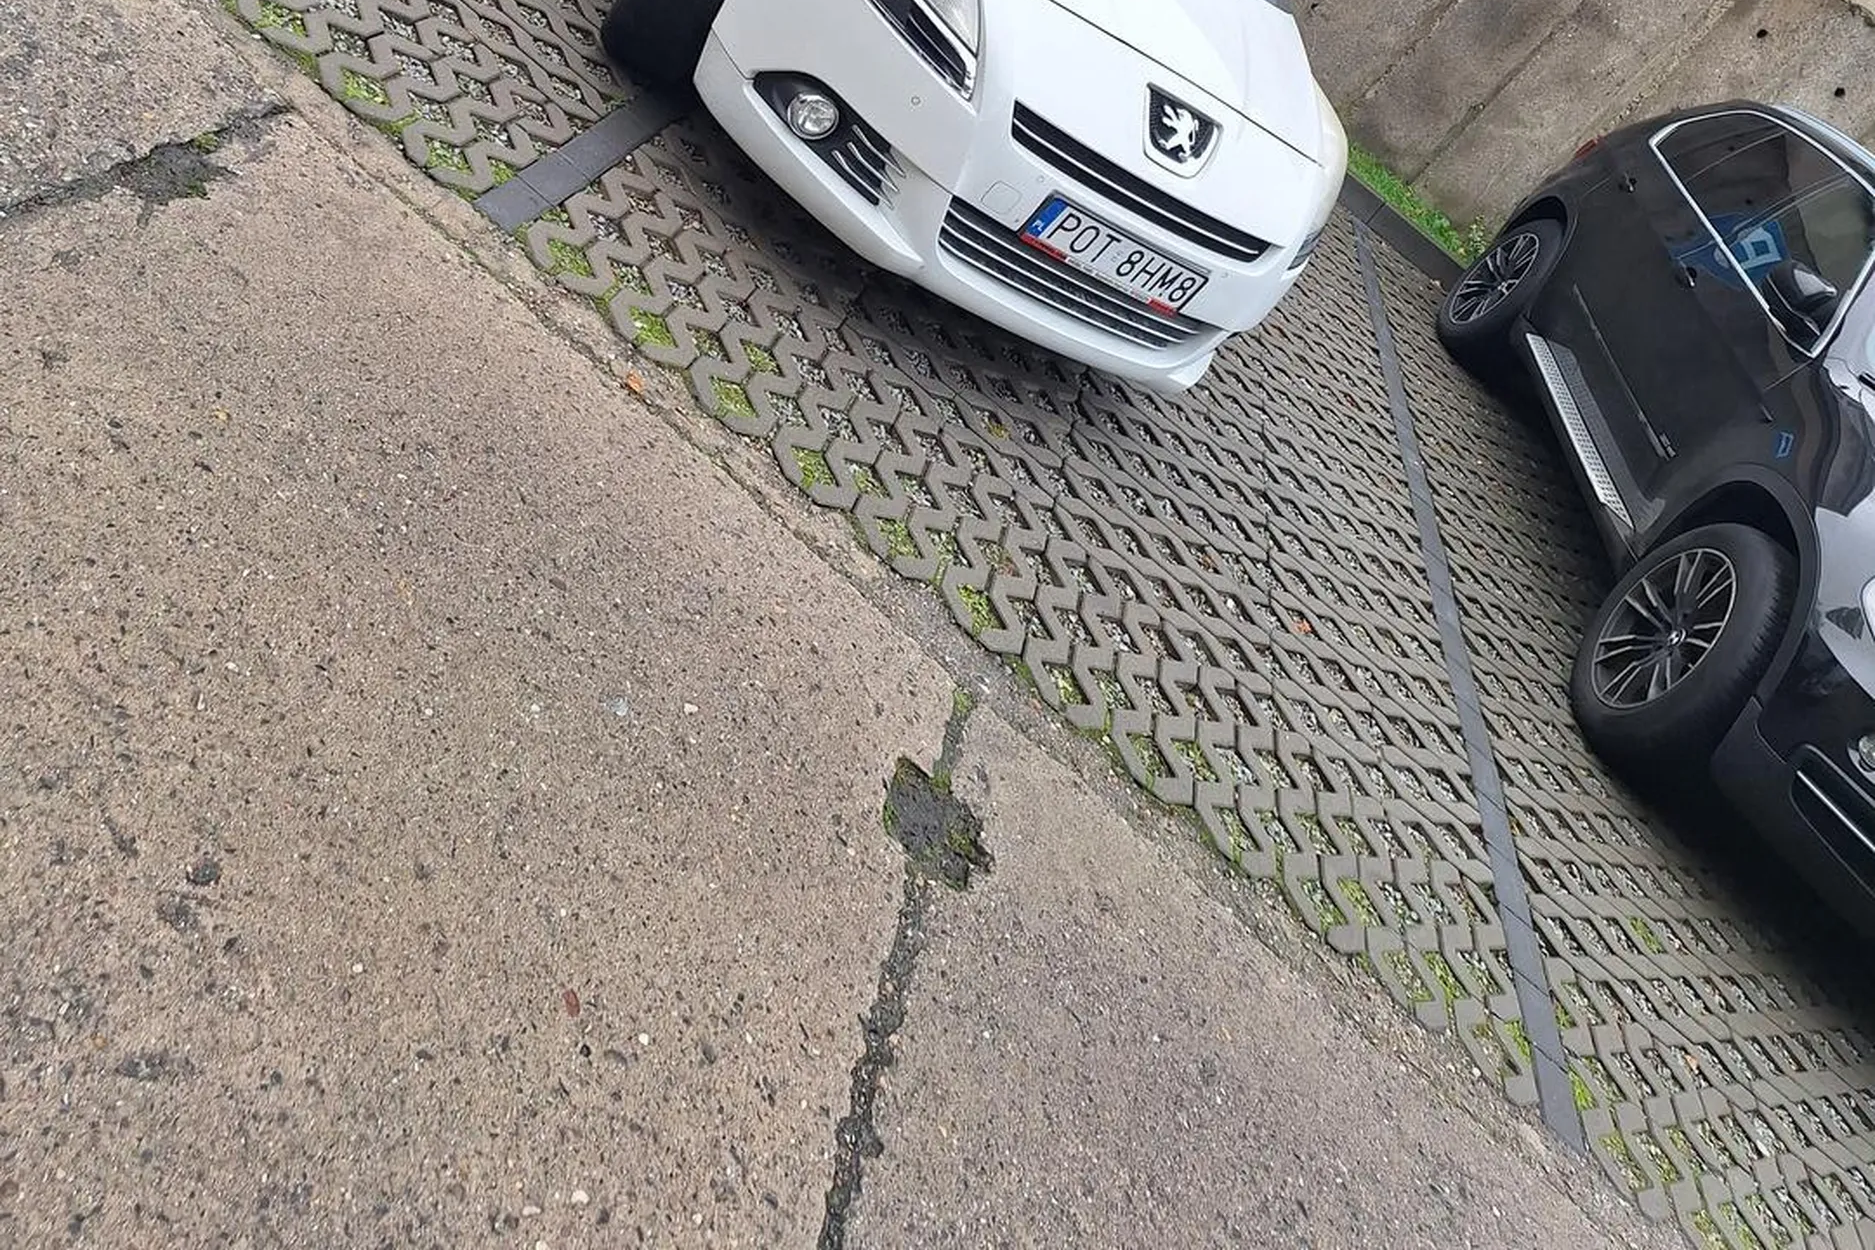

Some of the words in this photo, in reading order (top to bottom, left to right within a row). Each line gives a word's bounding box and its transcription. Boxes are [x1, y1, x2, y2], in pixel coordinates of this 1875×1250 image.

[1031, 219, 1046, 232] PL
[1047, 212, 1122, 263] POT
[1115, 250, 1197, 303] 8HM8
